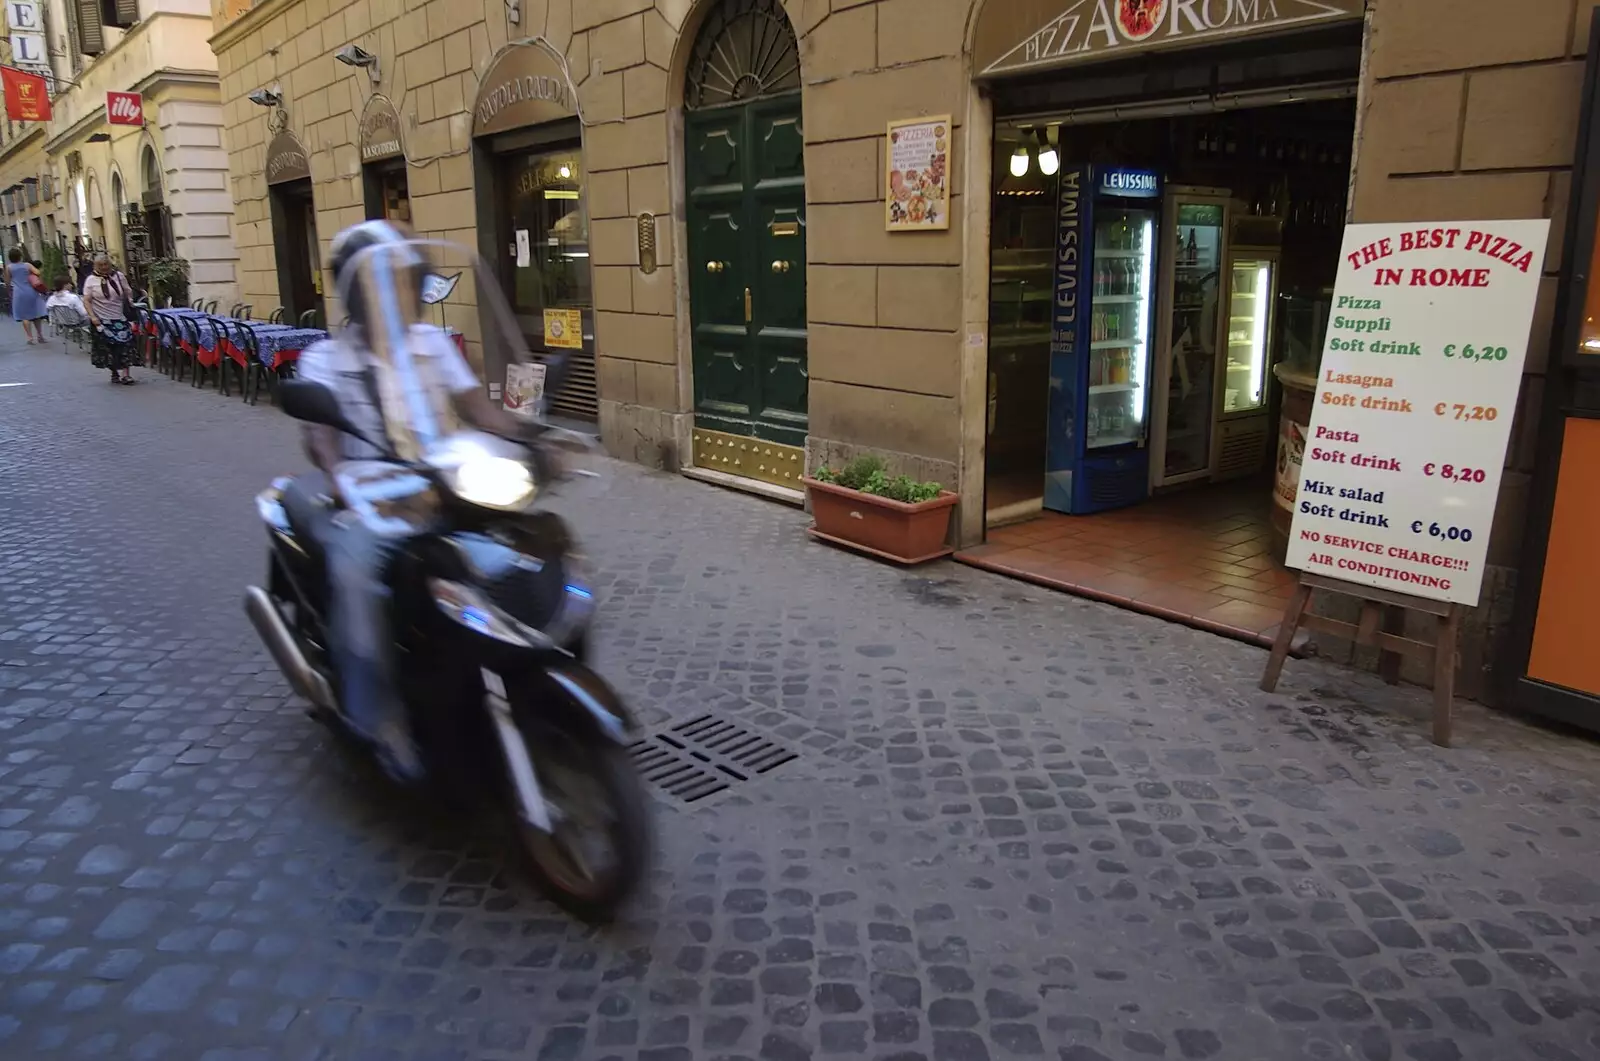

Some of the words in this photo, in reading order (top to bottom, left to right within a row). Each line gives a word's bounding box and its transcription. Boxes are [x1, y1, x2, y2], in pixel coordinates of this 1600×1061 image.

[1025, 0, 1119, 61] PIZZA
[1165, 0, 1278, 37] ROMA
[111, 98, 141, 121] illy
[478, 78, 523, 123] TAVOLA
[526, 75, 571, 111] CALDA
[899, 128, 933, 142] PIZZERIA
[1103, 173, 1157, 190] LEVISSIMA
[1056, 171, 1080, 323] LEVISSIMA
[1348, 238, 1394, 270] THE
[1400, 229, 1460, 251] BEST
[1465, 231, 1533, 272] PIZZA
[1374, 269, 1403, 285] IN
[1409, 269, 1490, 287] ROME
[1337, 296, 1381, 309] Pizza
[1334, 316, 1390, 332] Supplì
[1330, 338, 1364, 352] Soft
[1370, 341, 1420, 355] drink
[1444, 344, 1456, 357] €
[1462, 344, 1507, 362] 6,20
[1326, 371, 1393, 388] Lasagna
[1322, 392, 1356, 407] Soft
[1361, 396, 1412, 412] drink
[1434, 403, 1446, 415] €
[1453, 404, 1497, 421] 7,20
[1316, 426, 1358, 442] Pasta
[1312, 448, 1346, 463] Soft
[1351, 454, 1400, 471] drink
[1424, 463, 1435, 476] €
[1441, 464, 1485, 483] 8,20
[1304, 480, 1334, 495] Mix
[1339, 488, 1384, 503] salad
[1300, 501, 1334, 517] Soft
[1340, 508, 1388, 528] drink
[1411, 521, 1422, 533] €
[1429, 523, 1472, 542] 6,00
[1301, 530, 1320, 541] NO
[1324, 535, 1384, 554] SERVICE
[1387, 547, 1468, 571] CHARGE!!!
[1309, 553, 1333, 566] AIR
[1338, 558, 1452, 590] CONDITIONING
